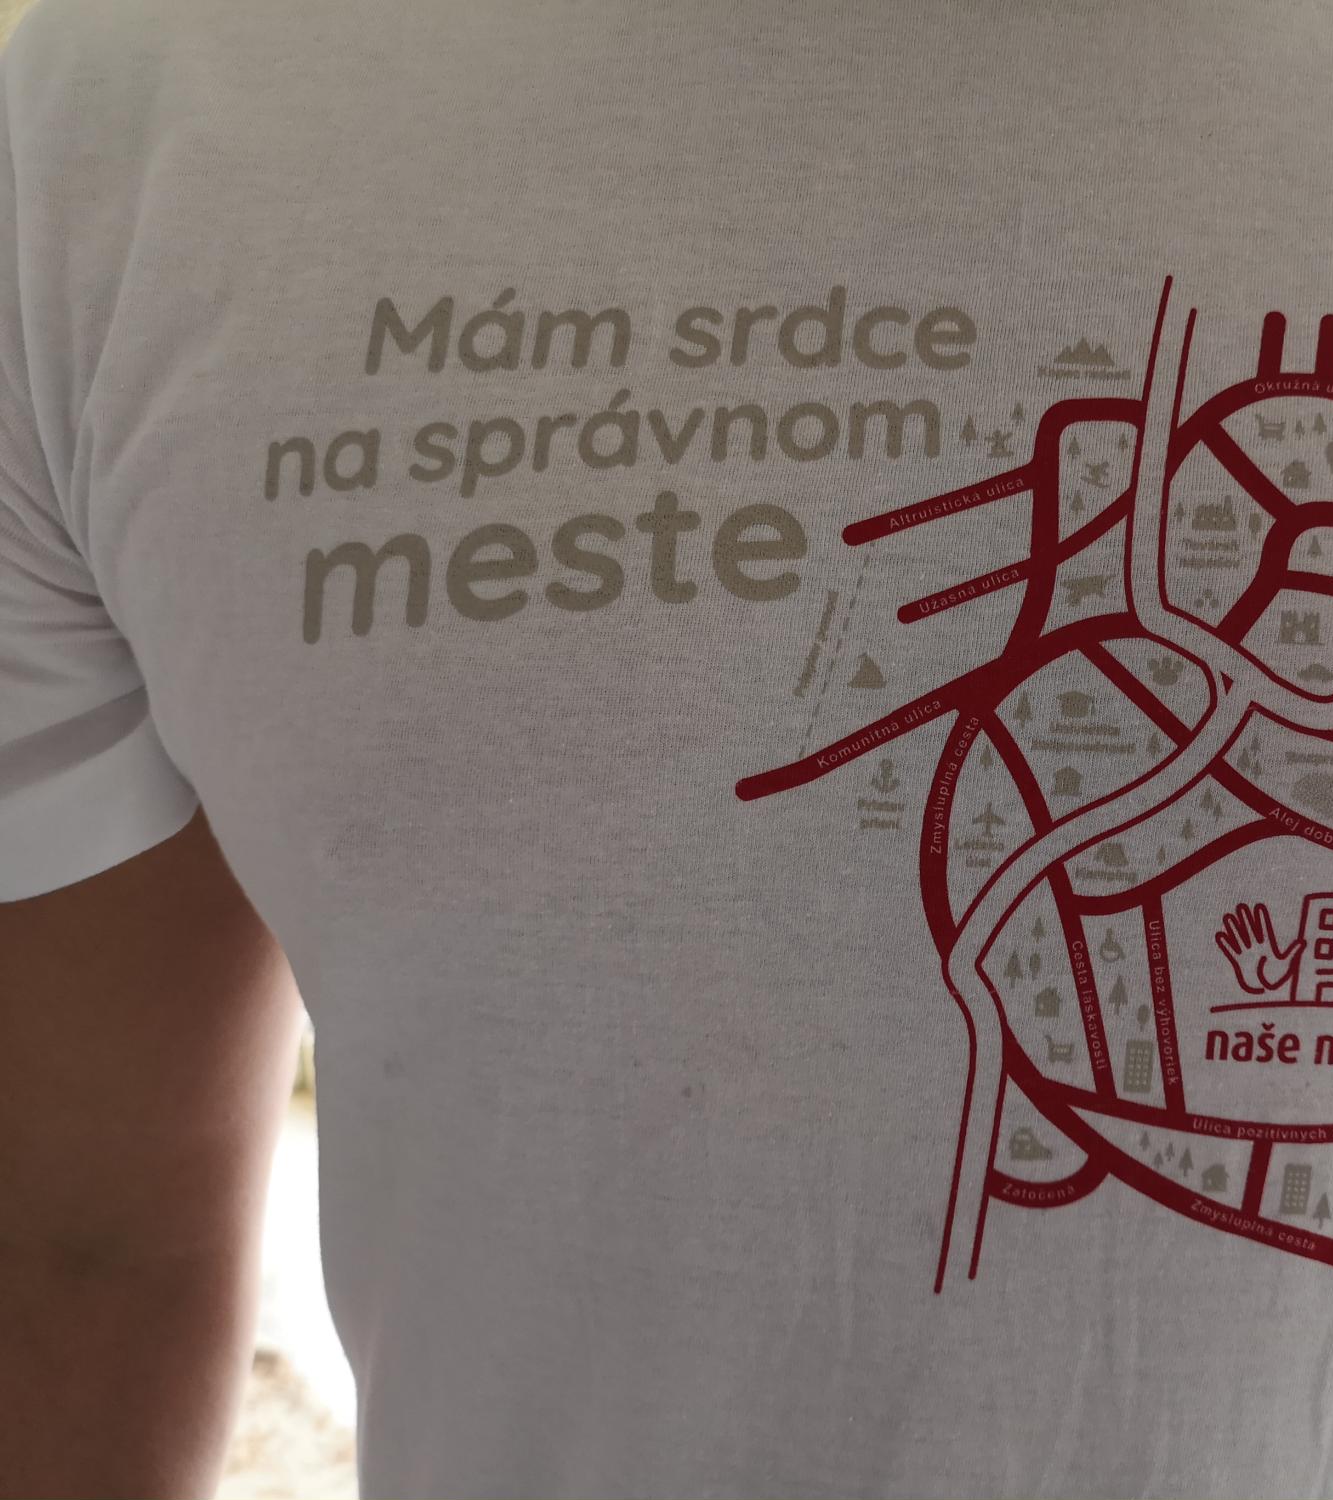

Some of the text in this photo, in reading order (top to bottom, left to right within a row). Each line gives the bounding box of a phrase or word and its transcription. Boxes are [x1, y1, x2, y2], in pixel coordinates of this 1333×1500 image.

[364, 284, 979, 376] Mám srdce
[1254, 378, 1321, 395] Okružná
[264, 387, 941, 501] na správnom
[889, 476, 1025, 530] Altruistická ulica
[301, 489, 809, 646] meste
[982, 567, 1020, 591] ulica
[816, 699, 942, 769] Komunitná ulica
[929, 715, 980, 856] Zmysluplná cesta
[1268, 805, 1300, 833] Alej
[1072, 940, 1107, 1070] Cesta láskavosti
[1149, 920, 1178, 1085] Ulica bez výhovoriek
[1205, 1021, 1301, 1063] naše
[1193, 1117, 1233, 1136] Ulica
[1236, 1124, 1327, 1142] pozitívnych
[1189, 1197, 1317, 1252] Zmysluplná cesta
